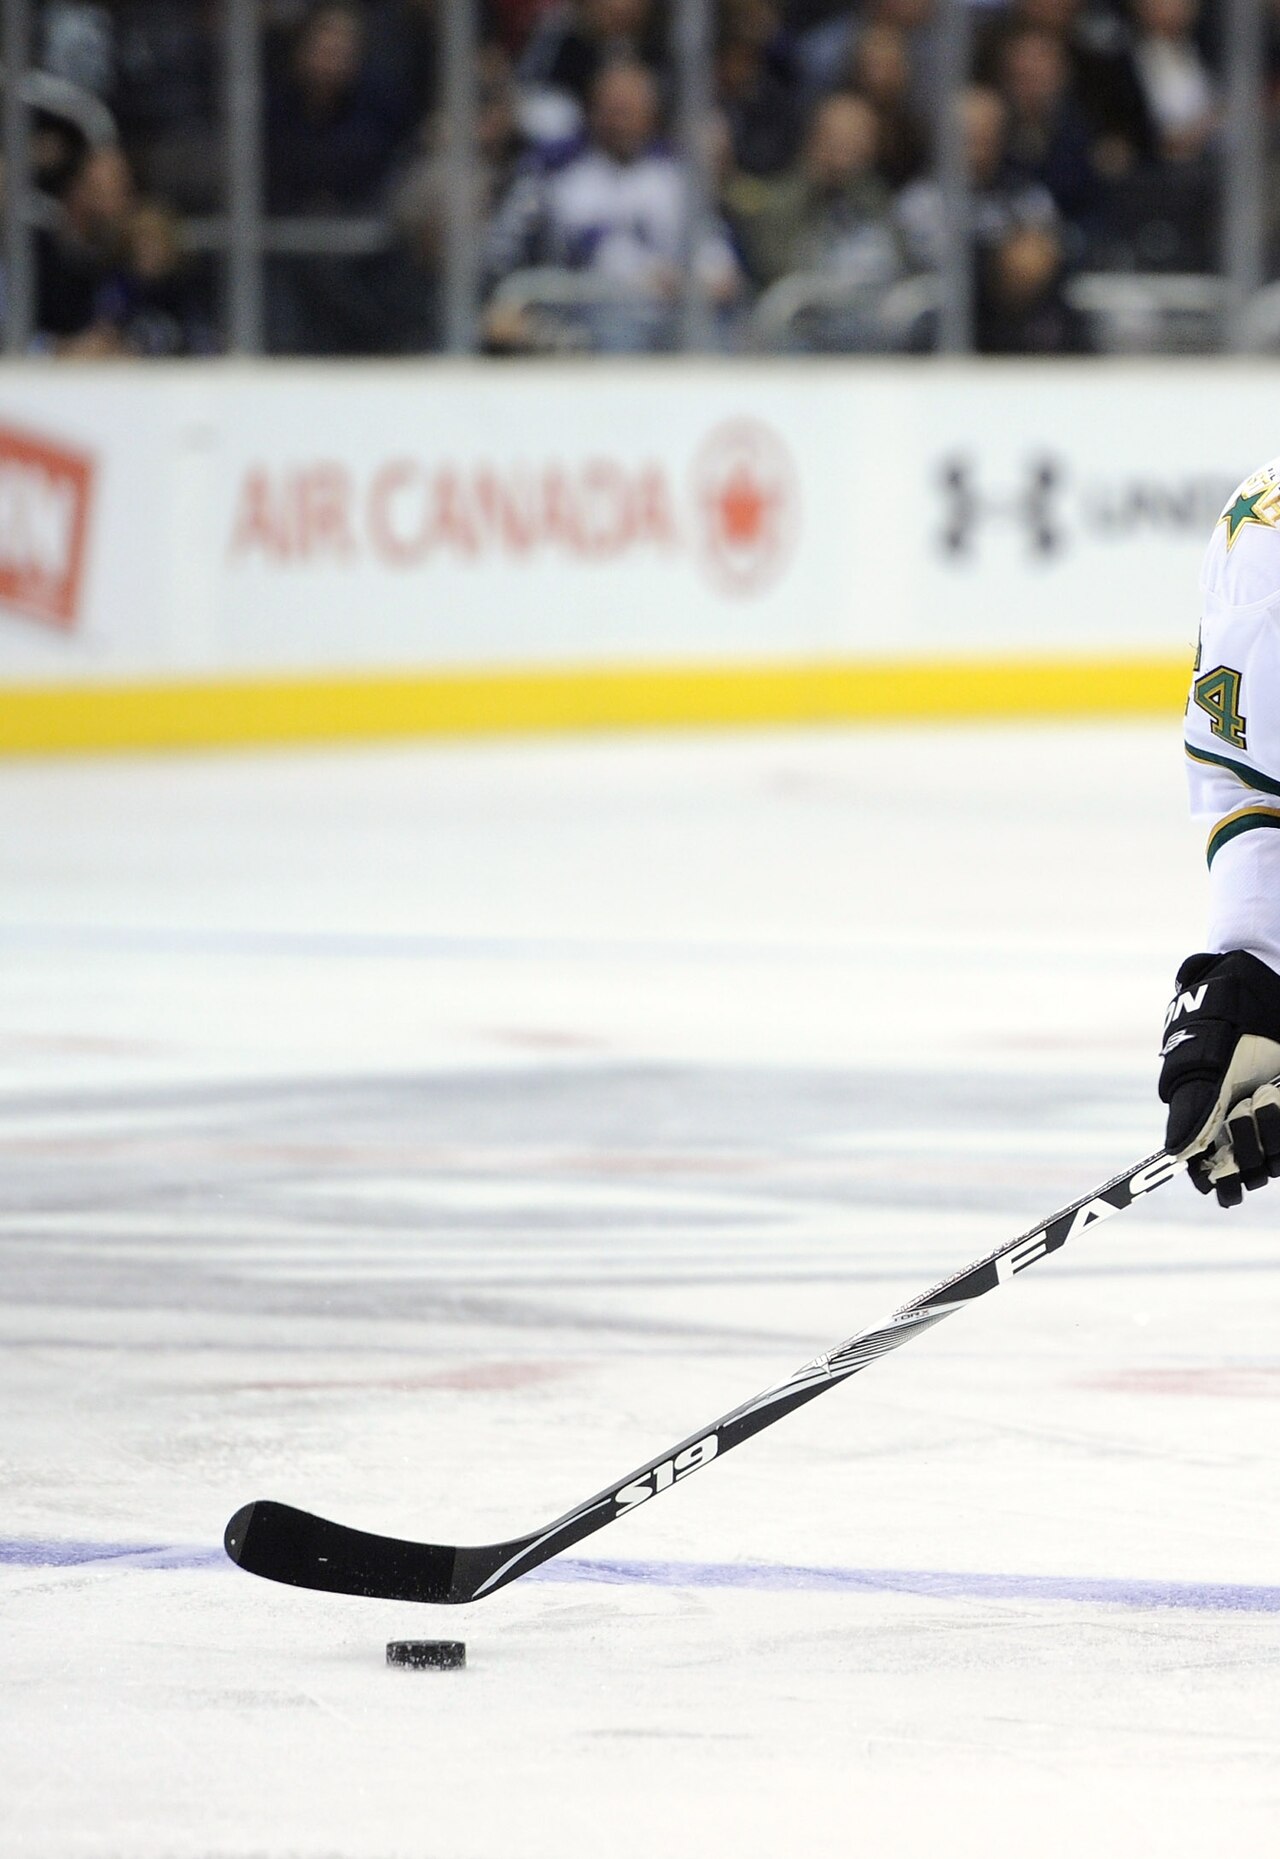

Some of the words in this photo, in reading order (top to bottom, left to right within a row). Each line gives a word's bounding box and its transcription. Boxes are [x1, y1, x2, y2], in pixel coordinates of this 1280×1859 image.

[233, 455, 354, 566] AIR
[366, 455, 682, 568] CANADA
[615, 1433, 719, 1518] S19
